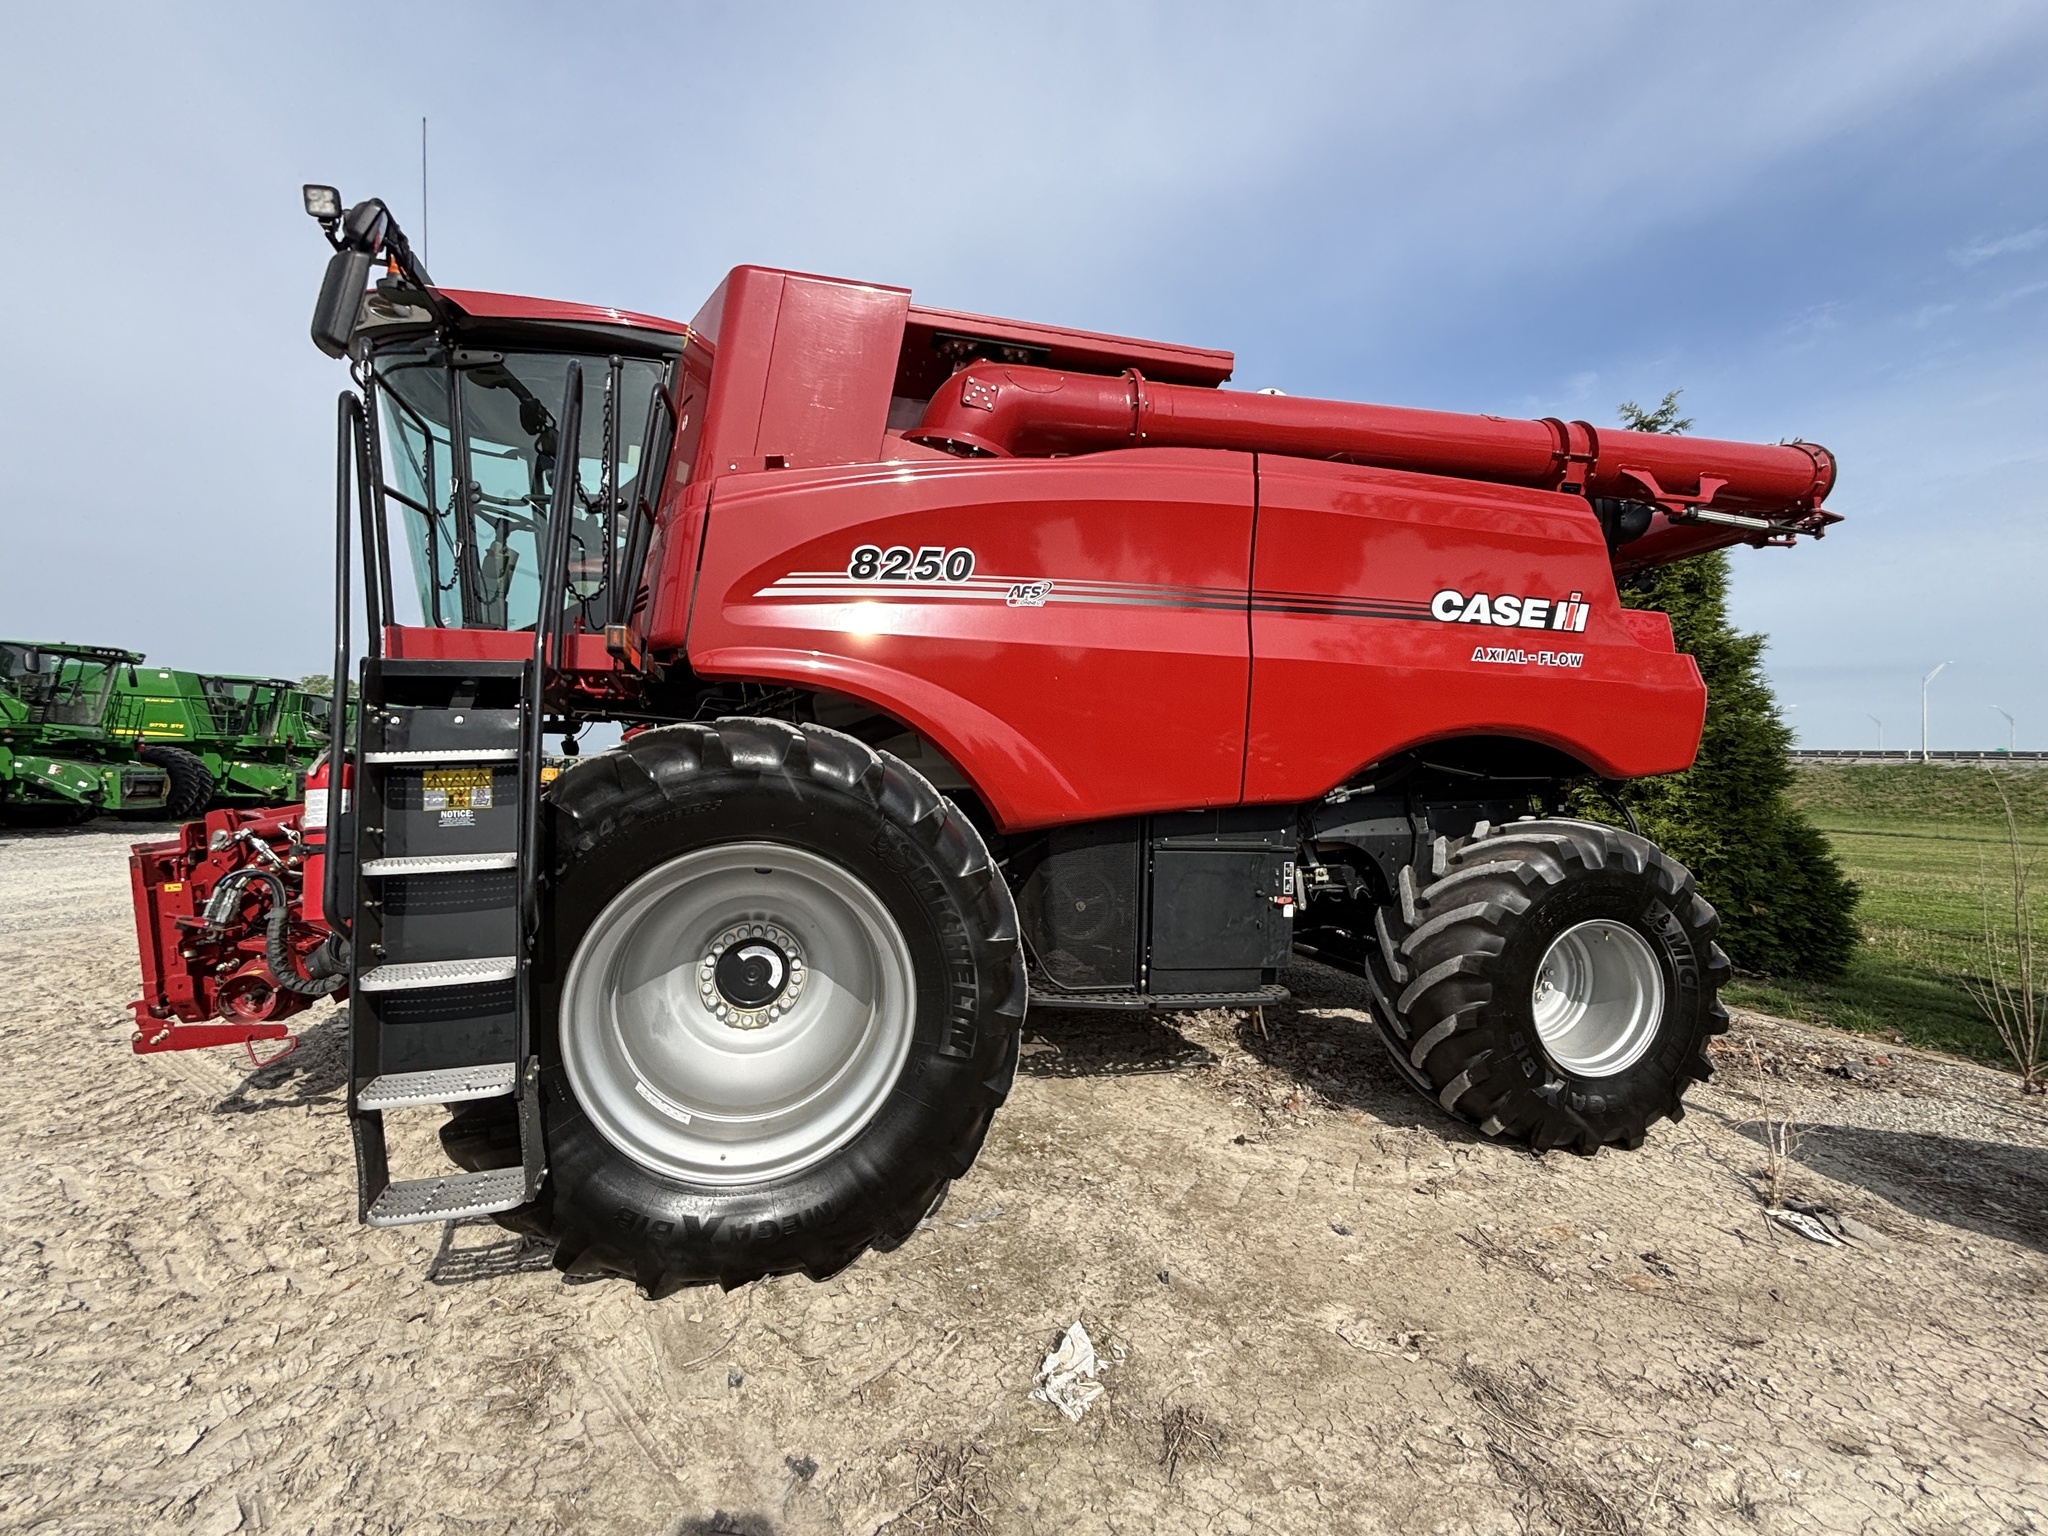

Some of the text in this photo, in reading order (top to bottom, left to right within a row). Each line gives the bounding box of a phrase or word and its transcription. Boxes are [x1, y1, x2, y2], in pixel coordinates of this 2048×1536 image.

[849, 545, 974, 582] 8250
[1008, 585, 1042, 598] AFS
[1431, 589, 1551, 628] CASE
[1471, 646, 1583, 667] AXIAL-FLOW
[440, 809, 474, 818] NOTICE:
[908, 861, 979, 1058] MICHELIN
